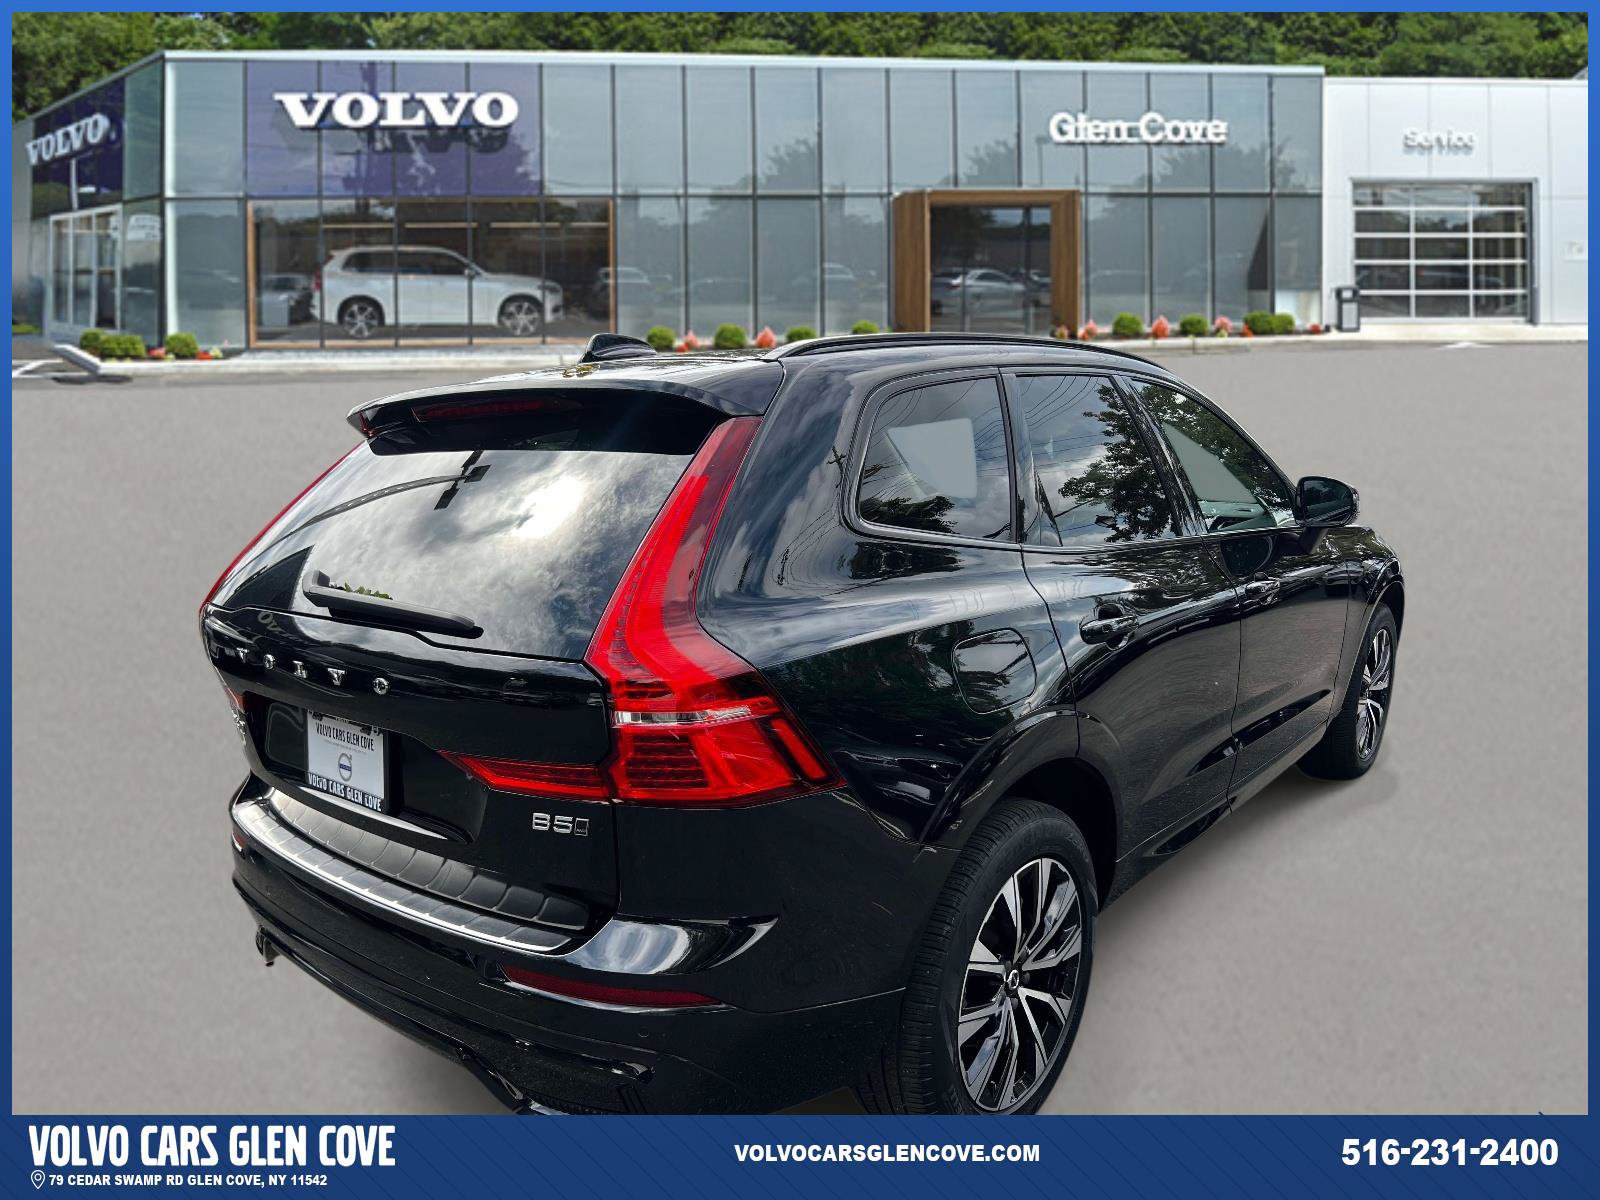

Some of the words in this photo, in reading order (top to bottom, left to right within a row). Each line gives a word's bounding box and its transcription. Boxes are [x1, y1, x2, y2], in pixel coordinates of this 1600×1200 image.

[274, 92, 519, 128] VOLVO
[1049, 111, 1129, 144] Glen
[1138, 111, 1228, 144] Cove
[26, 113, 111, 166] VOLVO
[236, 647, 391, 696] VOLVO
[315, 721, 332, 738] VOLVO
[332, 727, 346, 742] CARS
[346, 731, 360, 748] GLEN
[360, 735, 375, 752] COVE
[308, 773, 328, 791] VOLVO
[328, 780, 345, 798] CARS
[346, 787, 363, 804] GLEN
[364, 793, 382, 811] COVE
[532, 812, 573, 834] B5
